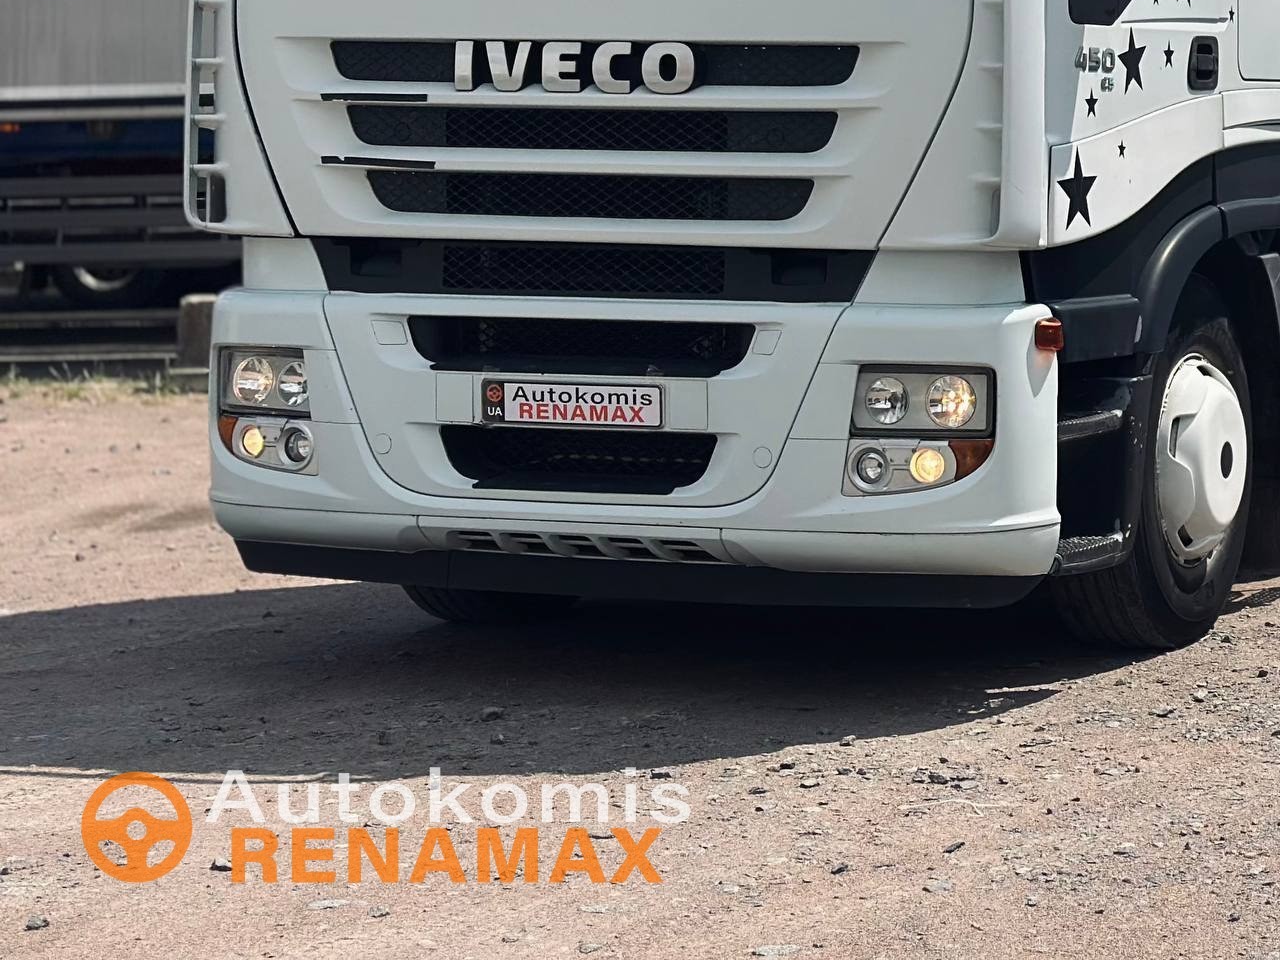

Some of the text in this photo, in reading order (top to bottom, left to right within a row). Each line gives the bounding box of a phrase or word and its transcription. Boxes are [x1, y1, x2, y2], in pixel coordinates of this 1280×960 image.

[454, 40, 695, 94] IVECO
[1075, 46, 1116, 74] 450
[512, 386, 653, 406] Autokomis
[487, 406, 503, 416] UA
[519, 403, 645, 423] RENAMAX
